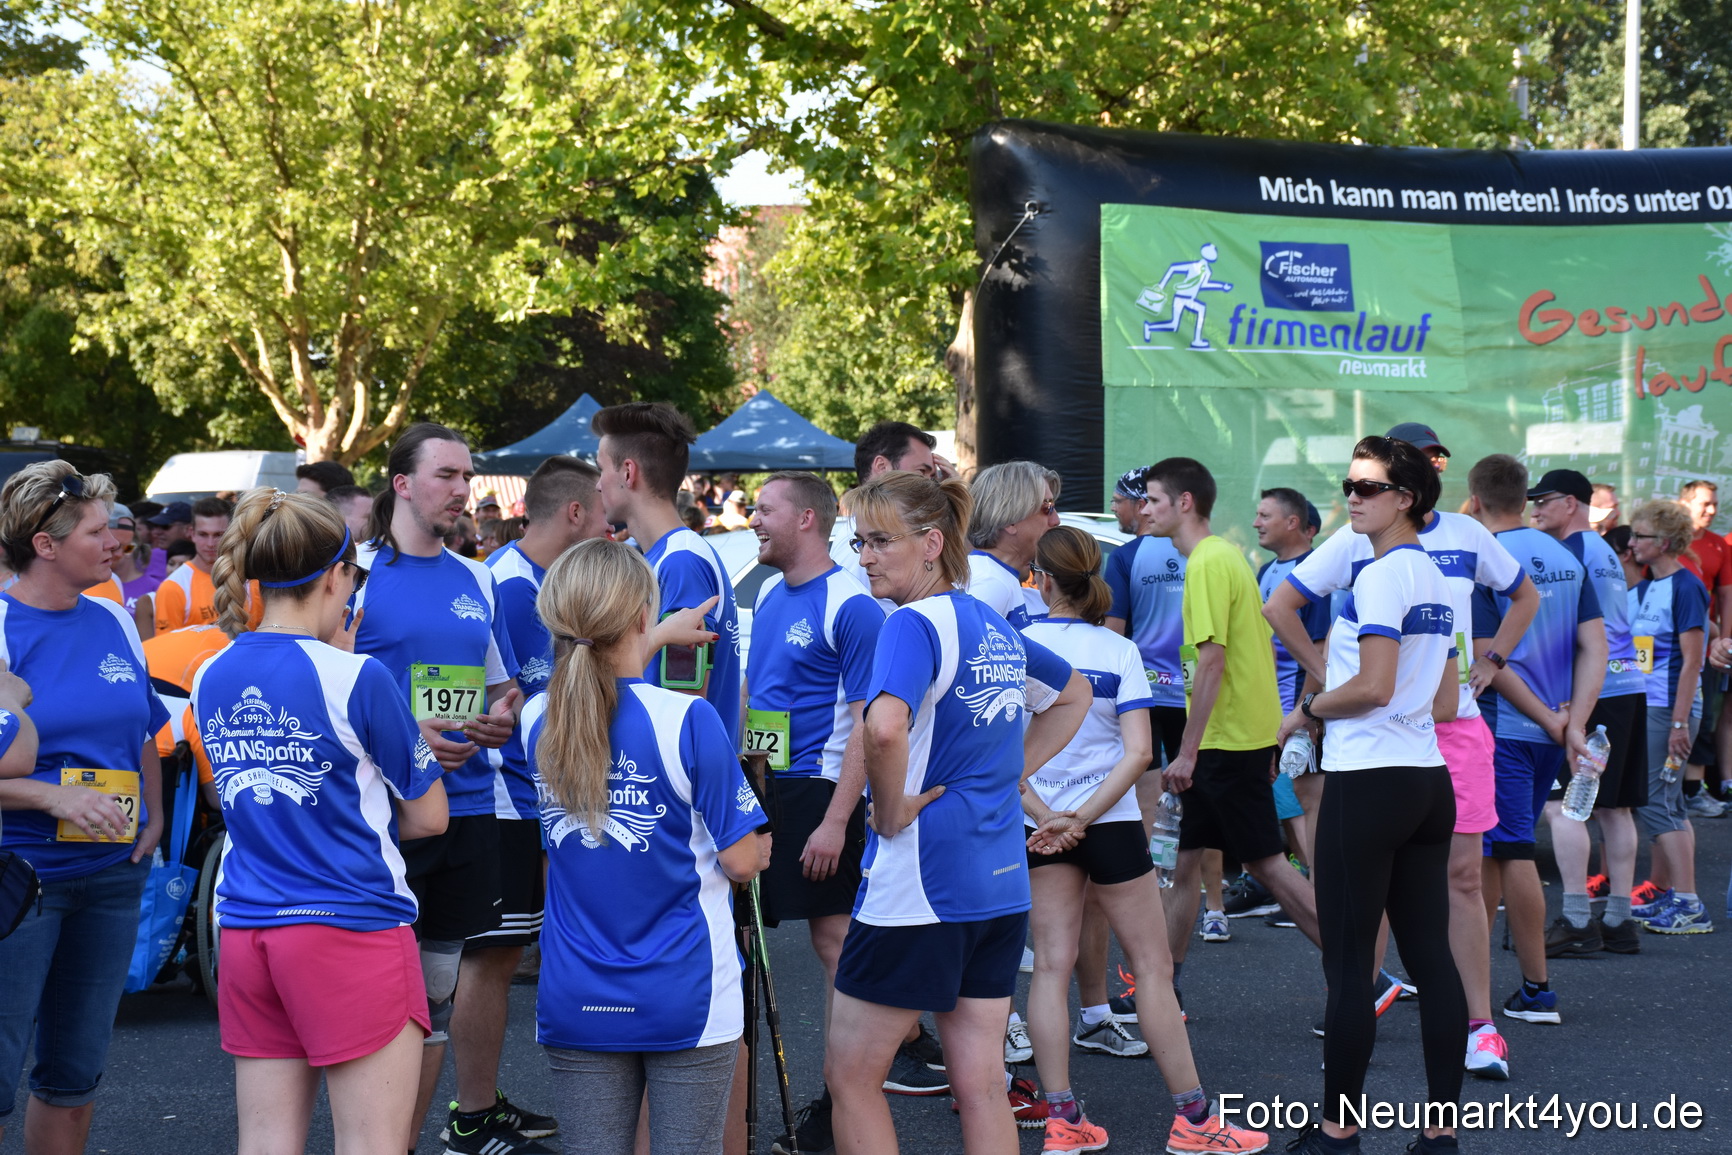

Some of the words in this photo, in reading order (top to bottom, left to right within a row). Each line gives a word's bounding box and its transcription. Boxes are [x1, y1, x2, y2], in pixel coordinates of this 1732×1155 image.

[1259, 176, 1325, 204] Mich
[1330, 179, 1394, 208] kann
[1401, 189, 1458, 210] man
[1464, 186, 1560, 212] mieten!
[1566, 187, 1629, 213] Infos
[1634, 188, 1701, 212] unter
[1278, 260, 1337, 277] Fischer
[1284, 276, 1334, 284] AUTOMOBILE
[1518, 274, 1732, 345] Gesund
[1228, 303, 1432, 352] firmenlauf
[1339, 358, 1428, 377] neumarkt
[422, 688, 477, 713] 1977
[243, 713, 263, 724] 1993
[220, 726, 255, 738] Premium
[256, 725, 285, 738] Products
[744, 730, 779, 753] 972
[206, 740, 315, 766] TRANSpofix
[233, 776, 244, 787] WE
